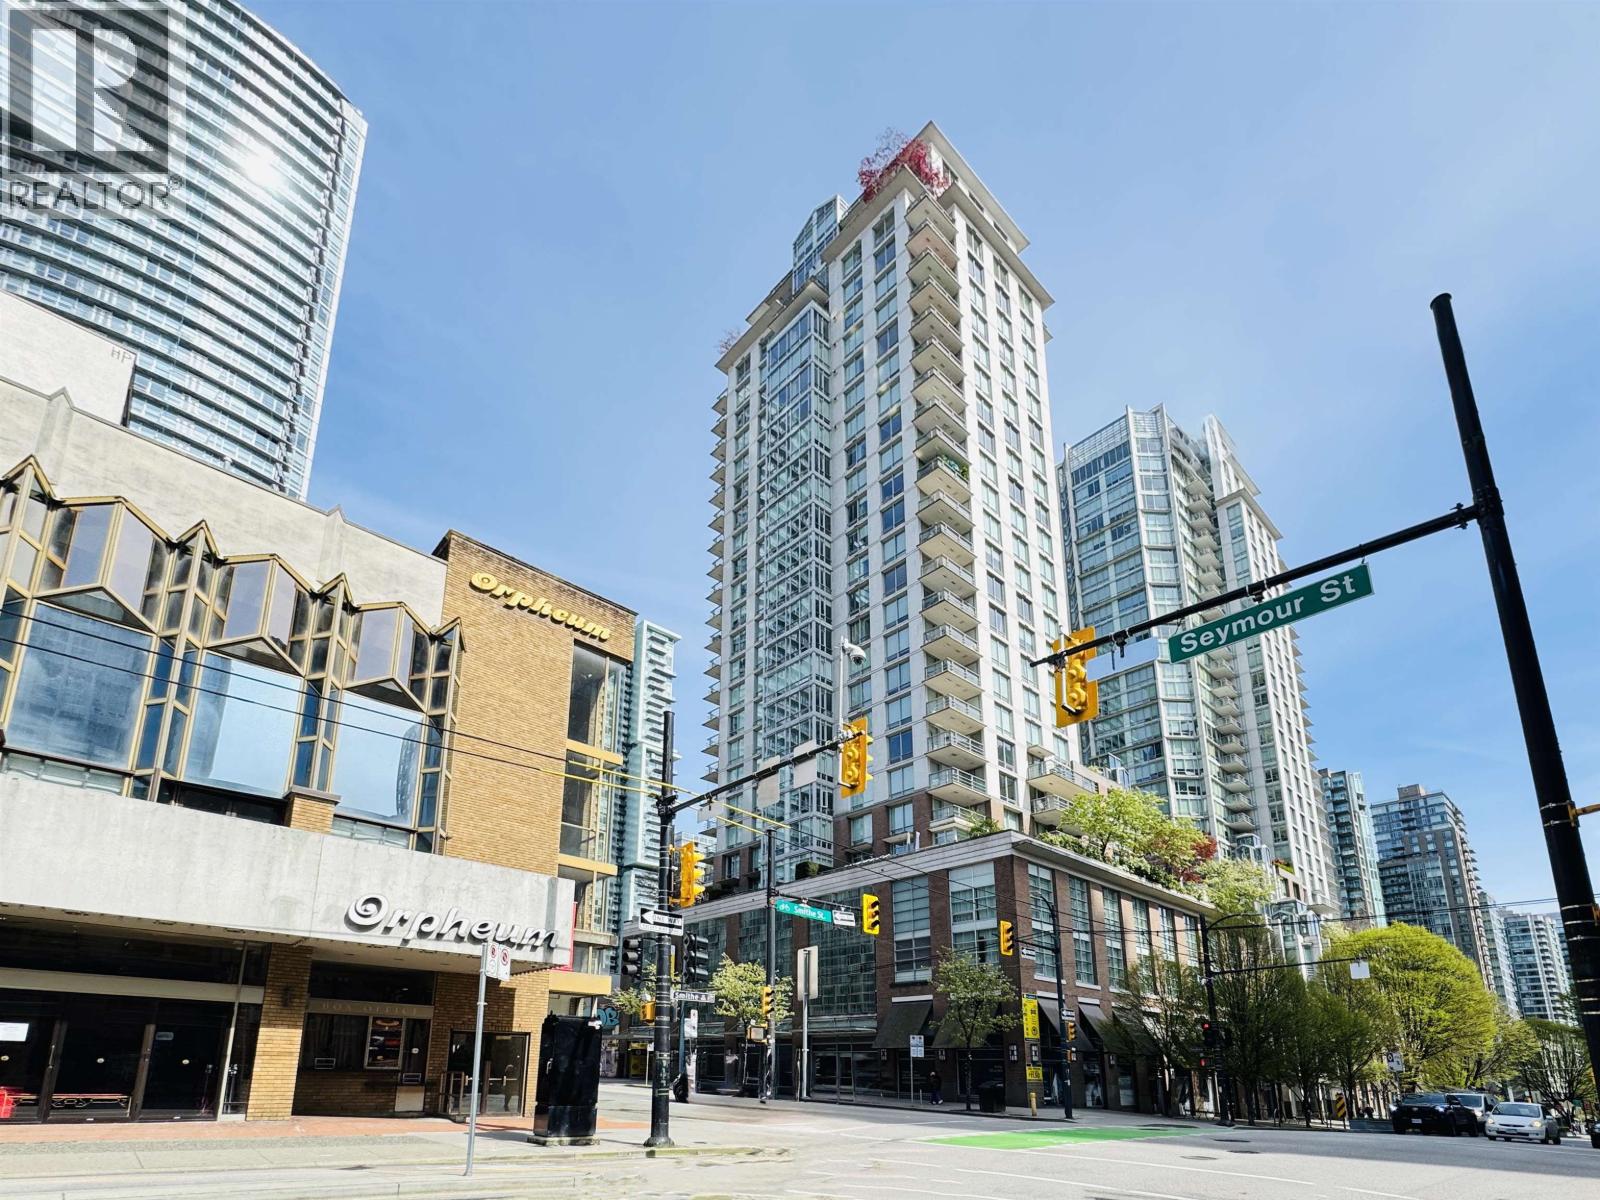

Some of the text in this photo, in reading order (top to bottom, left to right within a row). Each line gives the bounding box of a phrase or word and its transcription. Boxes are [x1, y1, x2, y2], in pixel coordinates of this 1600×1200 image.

[470, 572, 611, 641] Orpheum
[1180, 575, 1356, 653] Seymour St
[793, 905, 817, 917] Smithe
[345, 893, 559, 951] Orpheum
[652, 914, 682, 925] ONE WAY
[673, 991, 699, 1001] Smithe
[322, 1000, 417, 1016] BOX OFFICE
